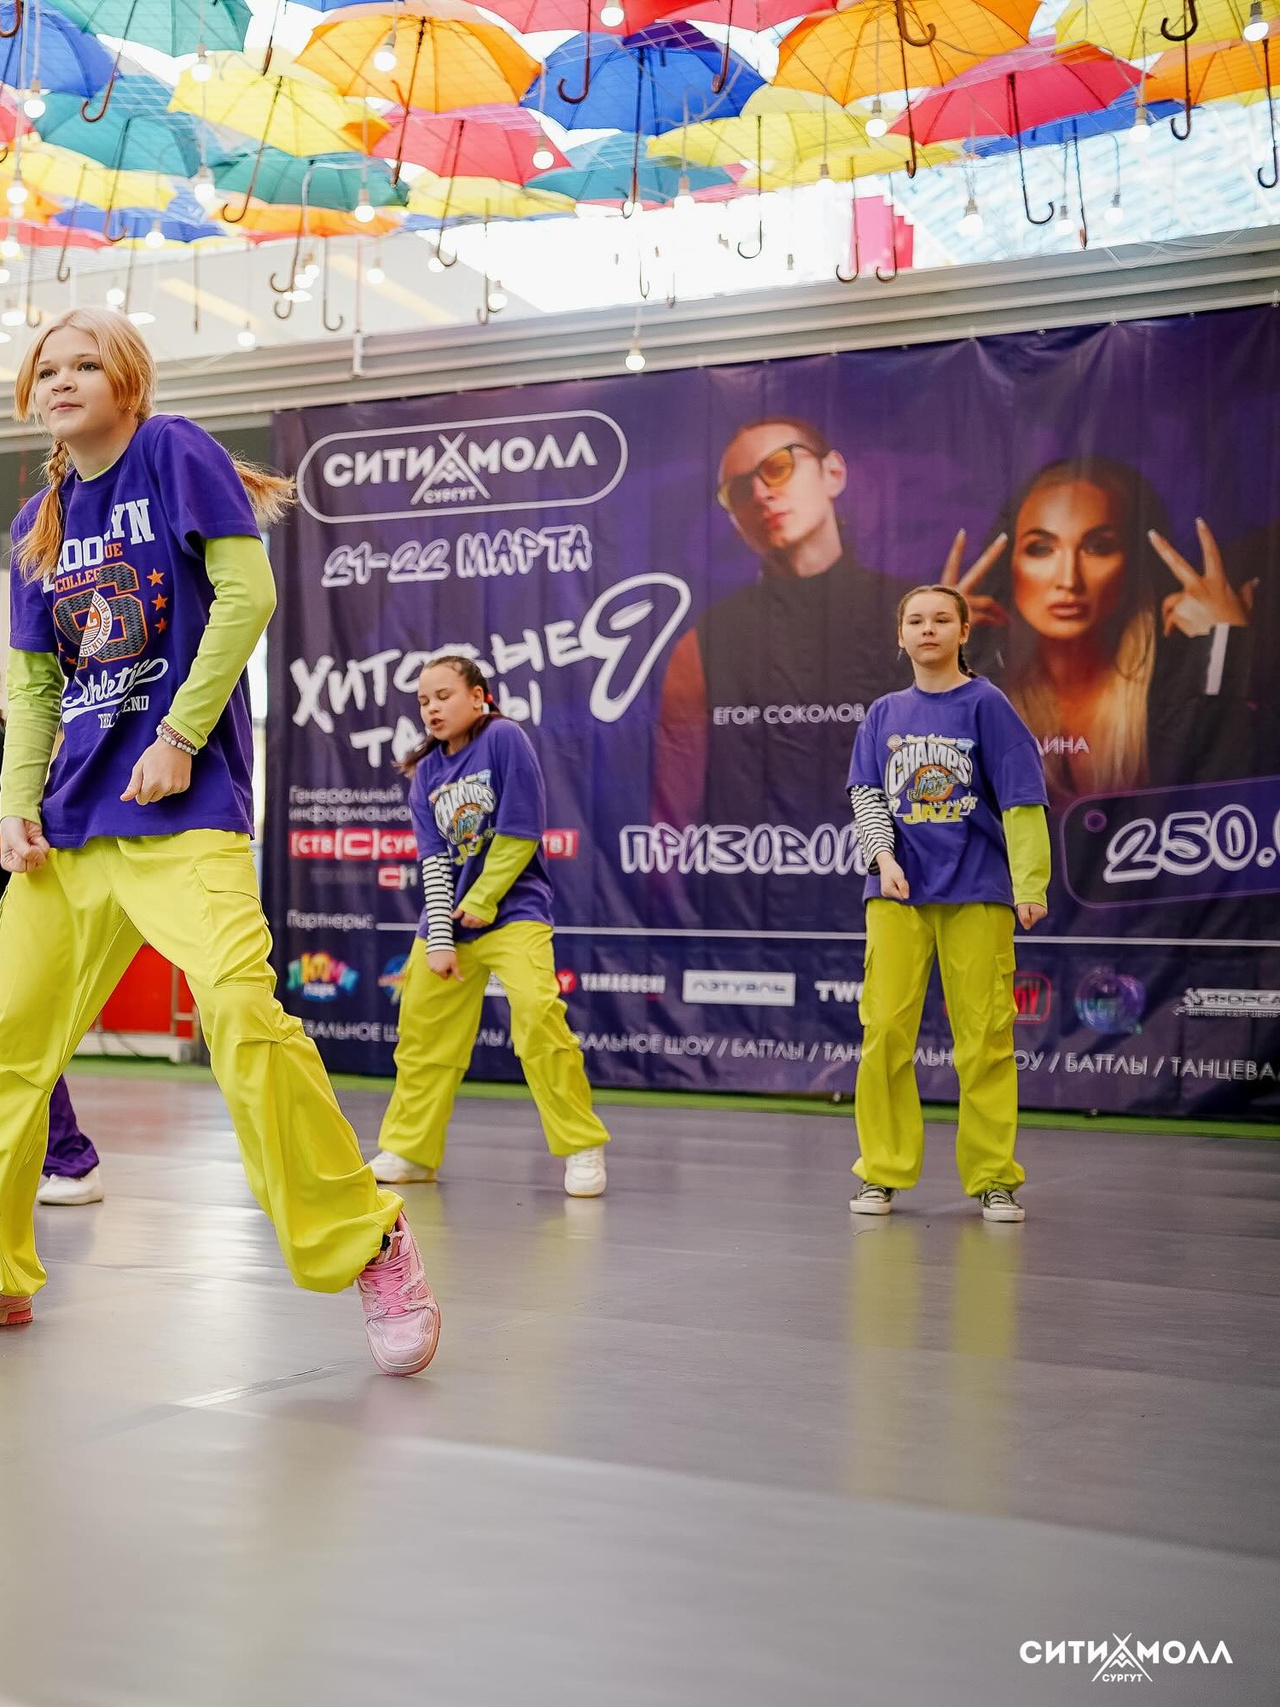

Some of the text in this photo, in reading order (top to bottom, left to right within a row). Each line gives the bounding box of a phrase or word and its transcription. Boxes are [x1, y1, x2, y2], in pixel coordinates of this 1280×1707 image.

[321, 524, 592, 588] 21-22 МАРТА
[713, 702, 866, 726] ЕГОР СОКОЛОВ
[1036, 737, 1089, 755] ИНА
[886, 743, 973, 800] CHAMPS
[903, 802, 963, 824] JAZZ
[664, 1036, 714, 1057] ШОУ
[1064, 1053, 1148, 1075] БАТТЛЫ
[1171, 1056, 1280, 1081] ТАНЦЕВА
